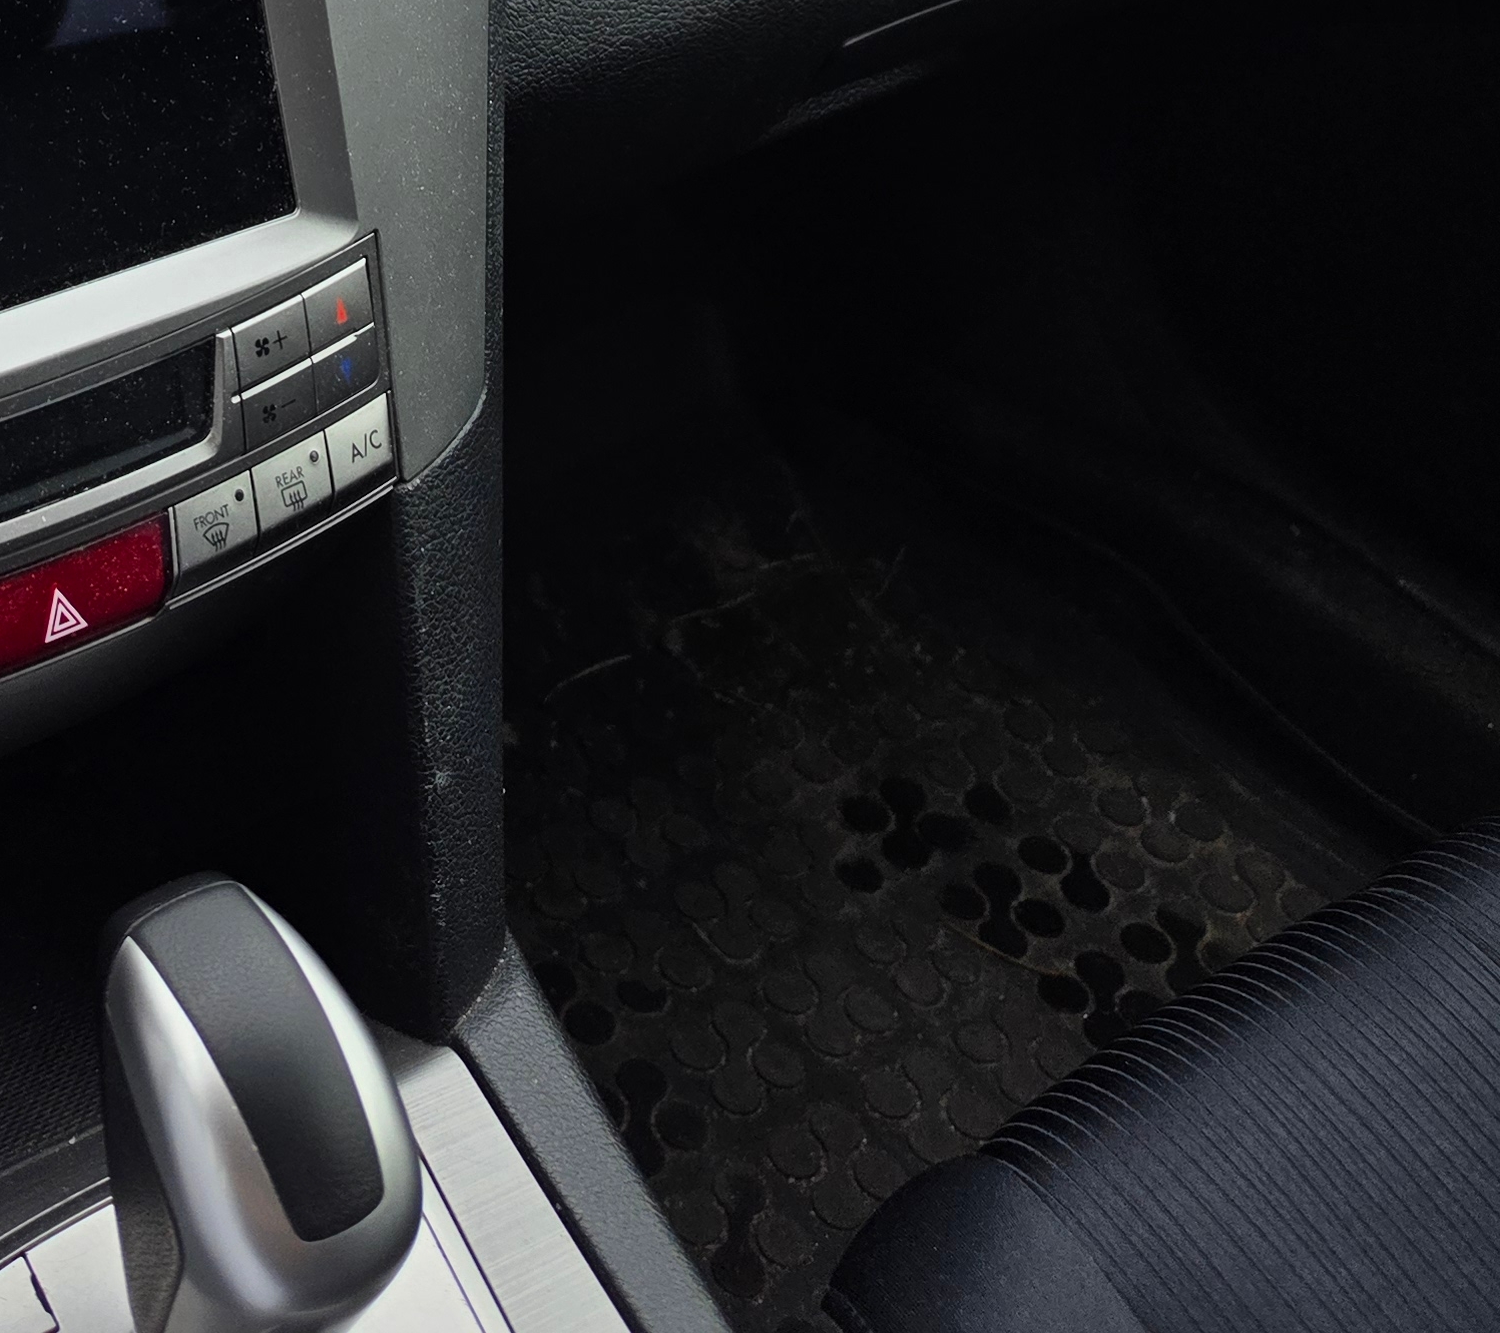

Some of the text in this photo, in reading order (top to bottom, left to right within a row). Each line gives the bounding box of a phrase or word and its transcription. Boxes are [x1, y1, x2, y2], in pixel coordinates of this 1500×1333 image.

[351, 429, 382, 463] A/C
[275, 466, 305, 489] REAR
[193, 504, 230, 531] FRONT
